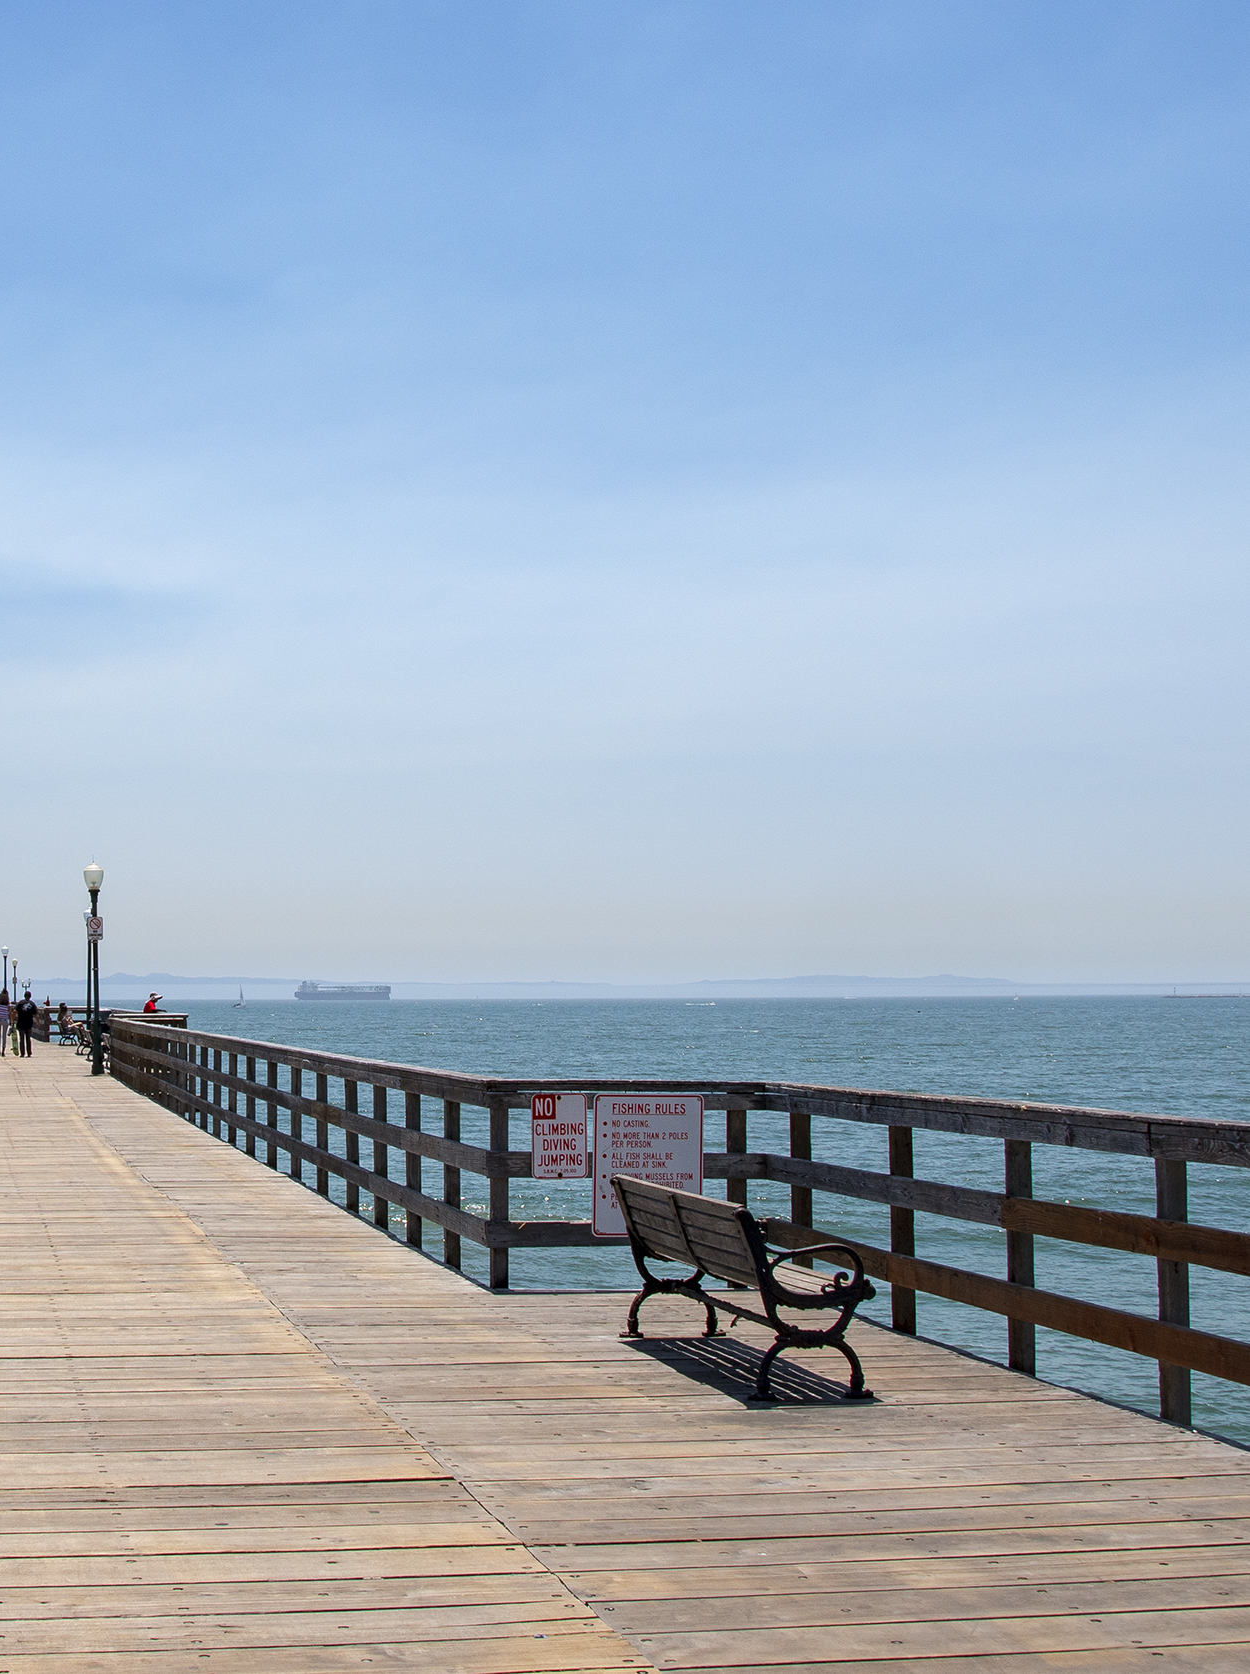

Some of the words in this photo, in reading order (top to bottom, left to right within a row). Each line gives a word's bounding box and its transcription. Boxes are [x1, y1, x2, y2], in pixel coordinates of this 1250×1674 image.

[535, 1097, 553, 1117] NO
[612, 1103, 650, 1114] FISHING
[655, 1103, 686, 1114] RULES
[535, 1122, 584, 1136] CLIMBING
[611, 1132, 620, 1140] NO
[623, 1132, 640, 1140] MORE
[643, 1132, 659, 1140] THAN
[662, 1132, 666, 1140] 2
[668, 1132, 688, 1140] POLES
[542, 1138, 577, 1151] DIVING
[611, 1140, 624, 1148] PER
[626, 1140, 653, 1148] PERSON.
[537, 1153, 583, 1167] JUMPING
[611, 1152, 623, 1160] ALL
[626, 1152, 640, 1160] FISH
[643, 1152, 663, 1160] SHALL
[665, 1152, 673, 1160] BE
